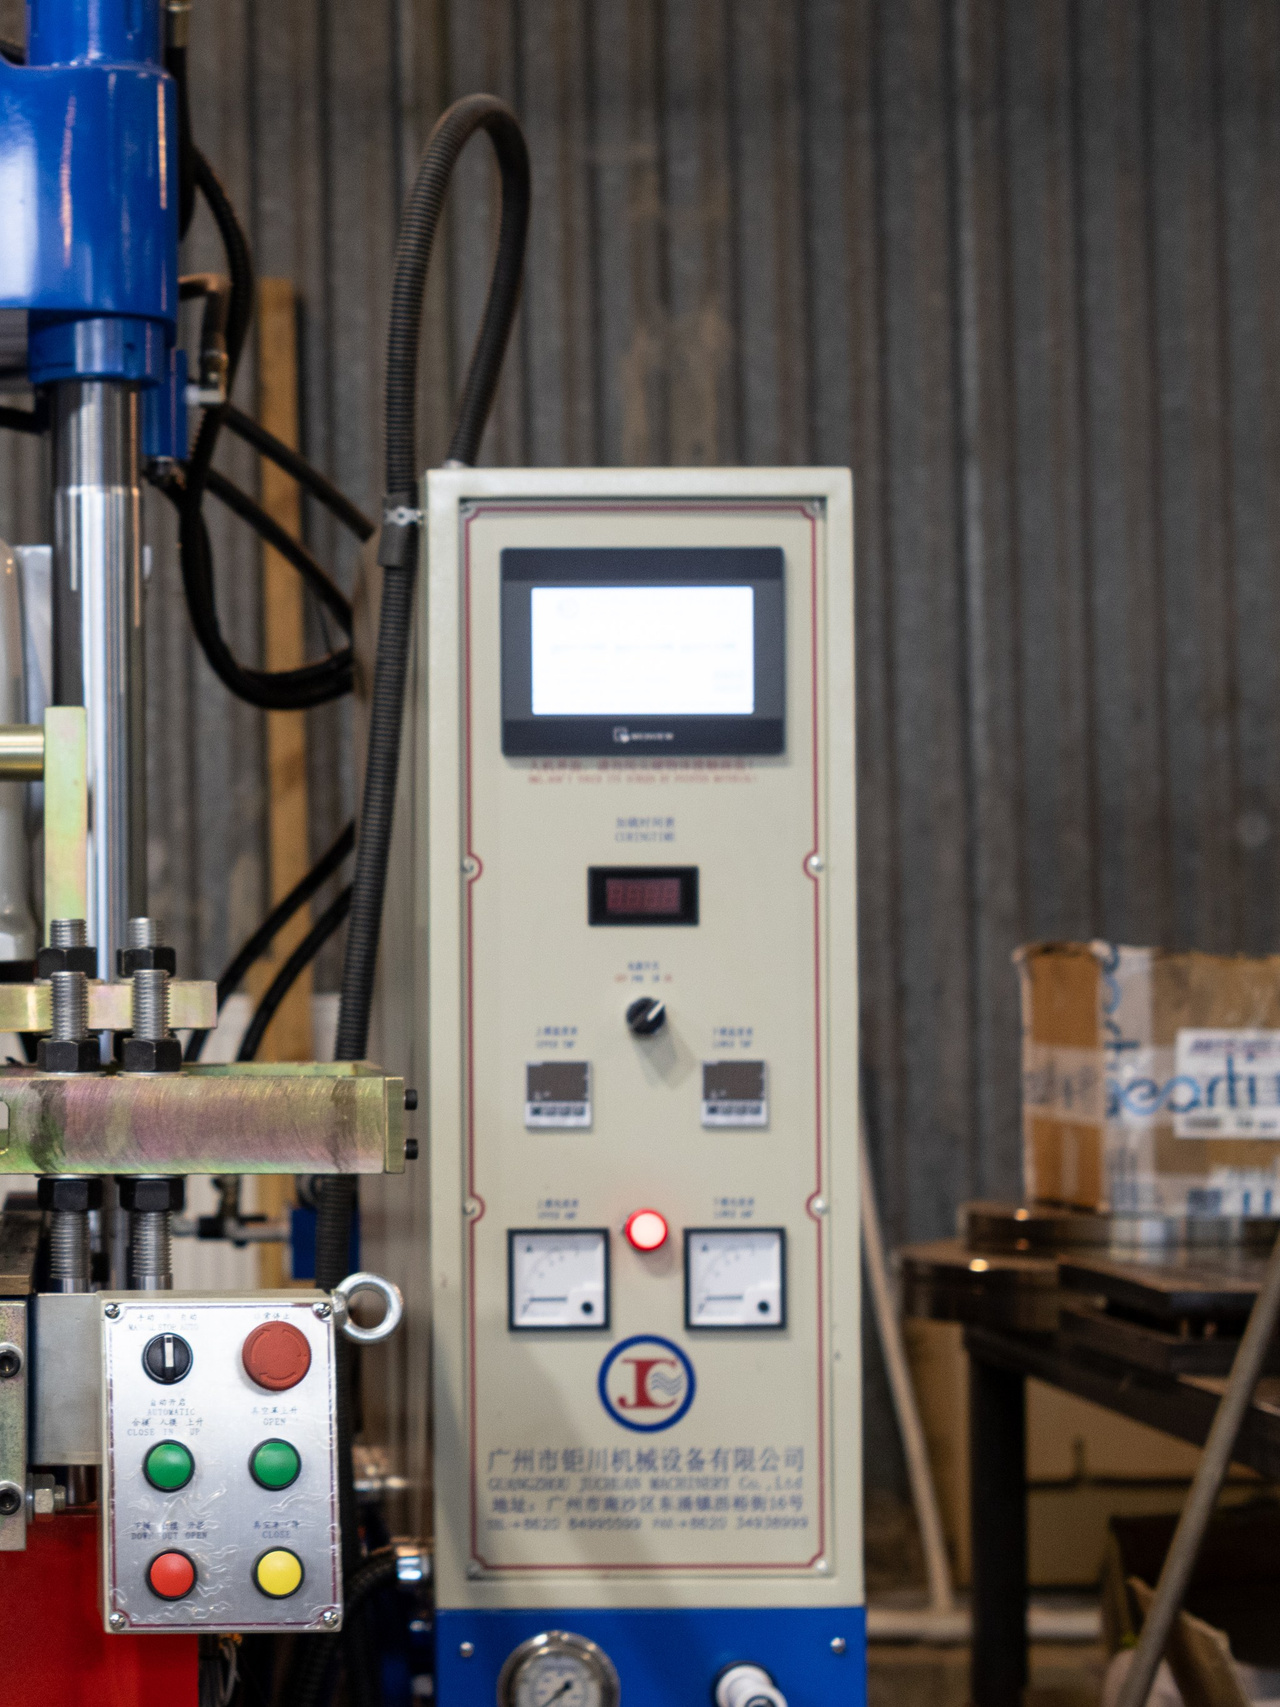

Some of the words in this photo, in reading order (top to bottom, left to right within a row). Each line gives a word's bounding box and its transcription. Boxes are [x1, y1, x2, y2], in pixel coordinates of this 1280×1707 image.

[147, 1408, 196, 1416] AUTOMATIC
[263, 1417, 286, 1426] OPEN
[127, 1428, 155, 1436] CLOSE
[190, 1427, 200, 1436] UP
[261, 1530, 291, 1539] CLOSE
